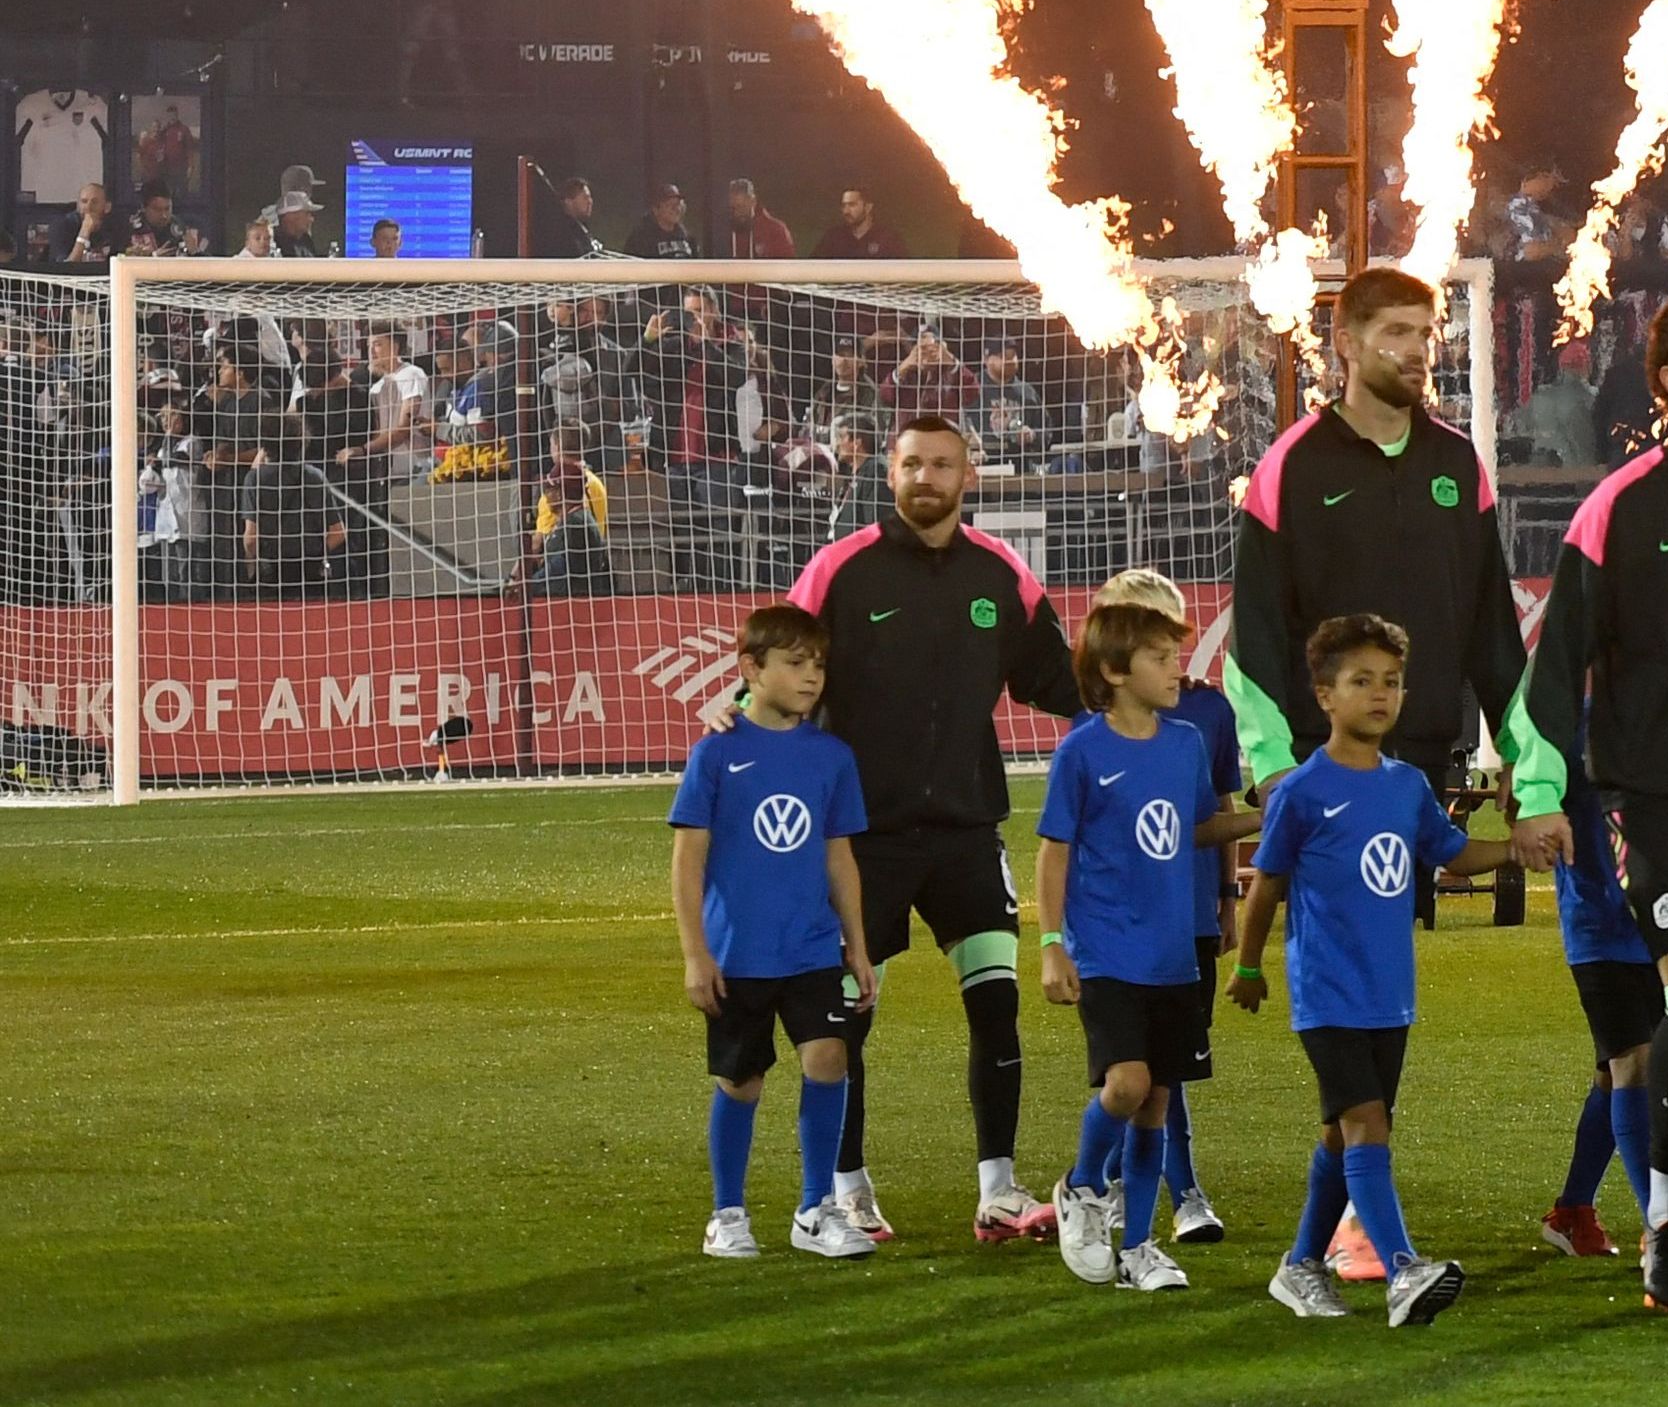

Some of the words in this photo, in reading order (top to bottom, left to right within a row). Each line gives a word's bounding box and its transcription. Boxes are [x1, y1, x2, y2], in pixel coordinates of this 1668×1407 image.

[393, 147, 452, 159] USMNT
[142, 679, 237, 734] OF
[259, 670, 607, 731] AMERICA
[754, 795, 811, 852] VW
[1136, 799, 1180, 860] VW
[1361, 832, 1410, 897] VW
